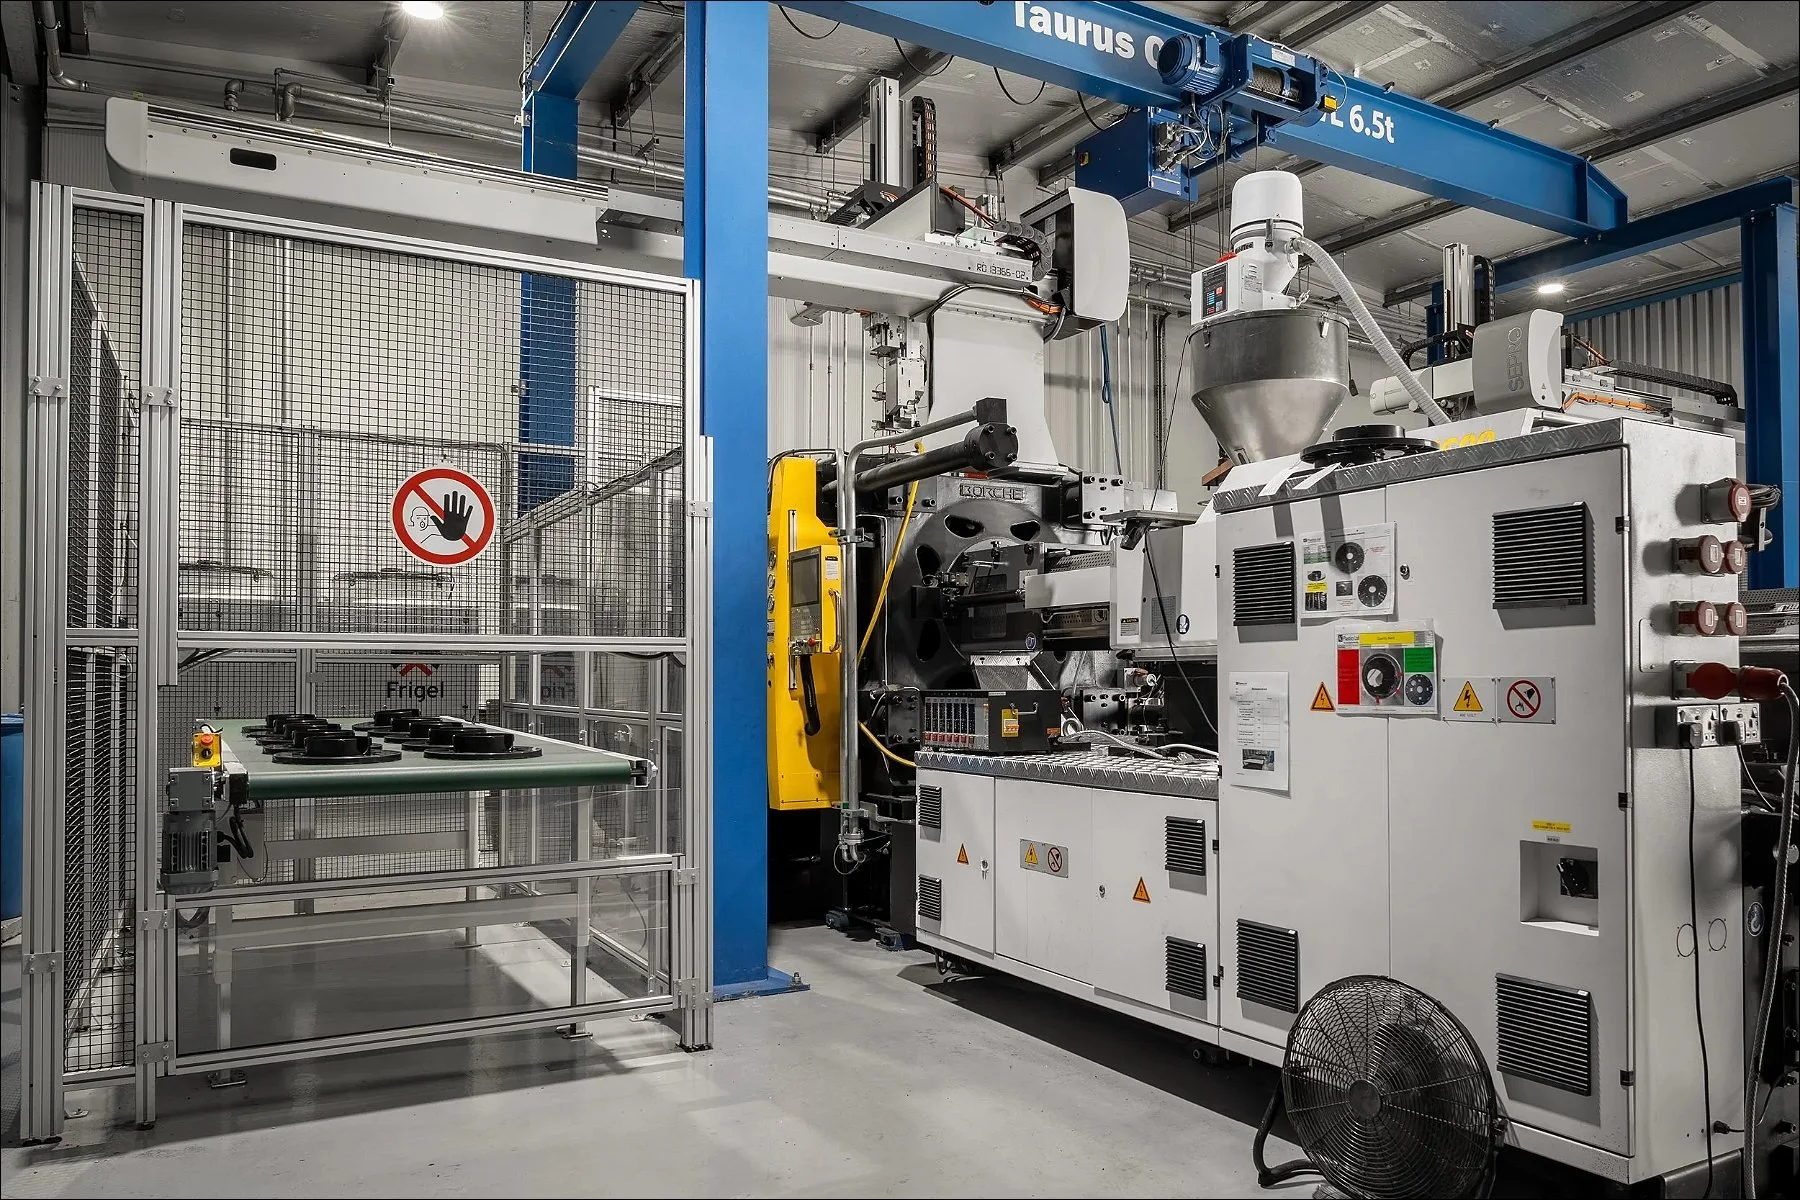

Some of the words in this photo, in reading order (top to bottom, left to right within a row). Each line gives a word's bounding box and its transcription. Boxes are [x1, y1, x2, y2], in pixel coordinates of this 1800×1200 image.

[1015, 1, 1135, 59] Taurus
[1350, 105, 1395, 144] 6.5t
[959, 483, 1025, 501] BORCHE
[386, 681, 444, 702] Frigel
